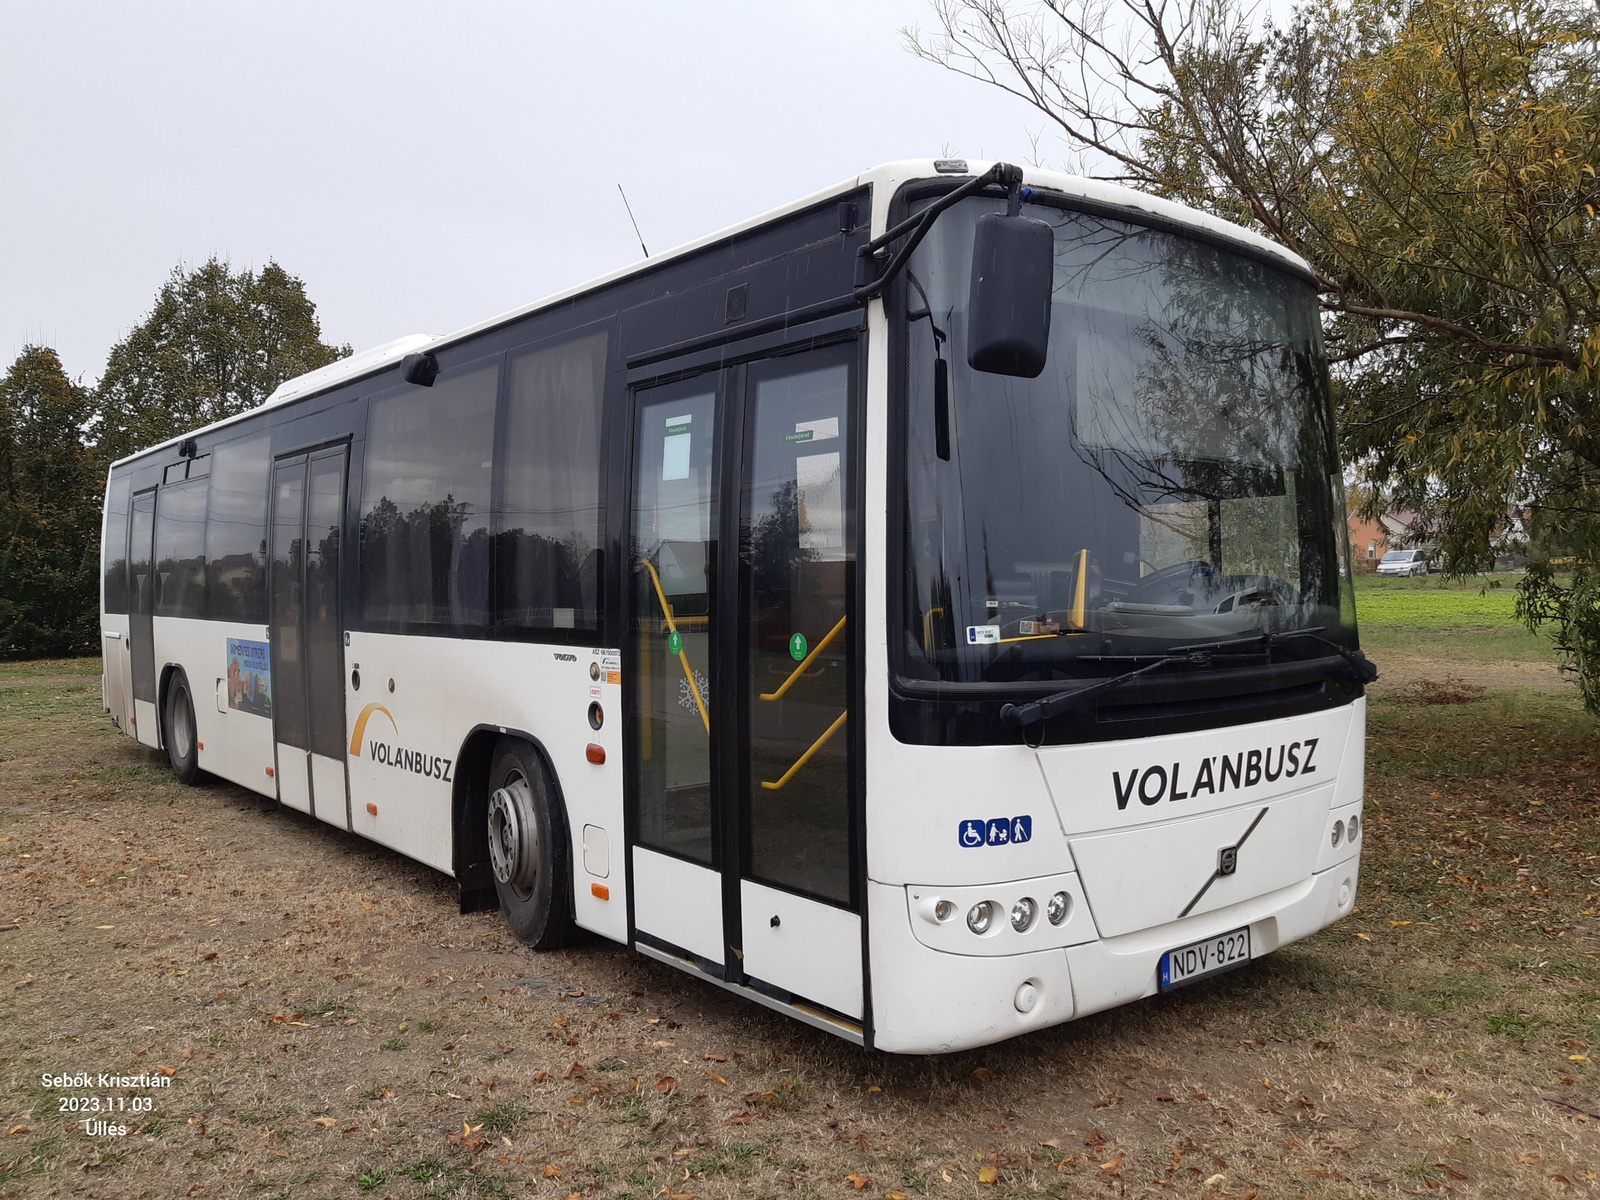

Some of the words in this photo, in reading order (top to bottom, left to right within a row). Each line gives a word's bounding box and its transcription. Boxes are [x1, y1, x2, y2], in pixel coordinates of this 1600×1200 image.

[370, 740, 452, 783] VOLÁNBUSZ
[1112, 738, 1319, 811] VOLÁNBUSZ
[1163, 972, 1169, 981] H
[1173, 934, 1246, 980] NDV-822
